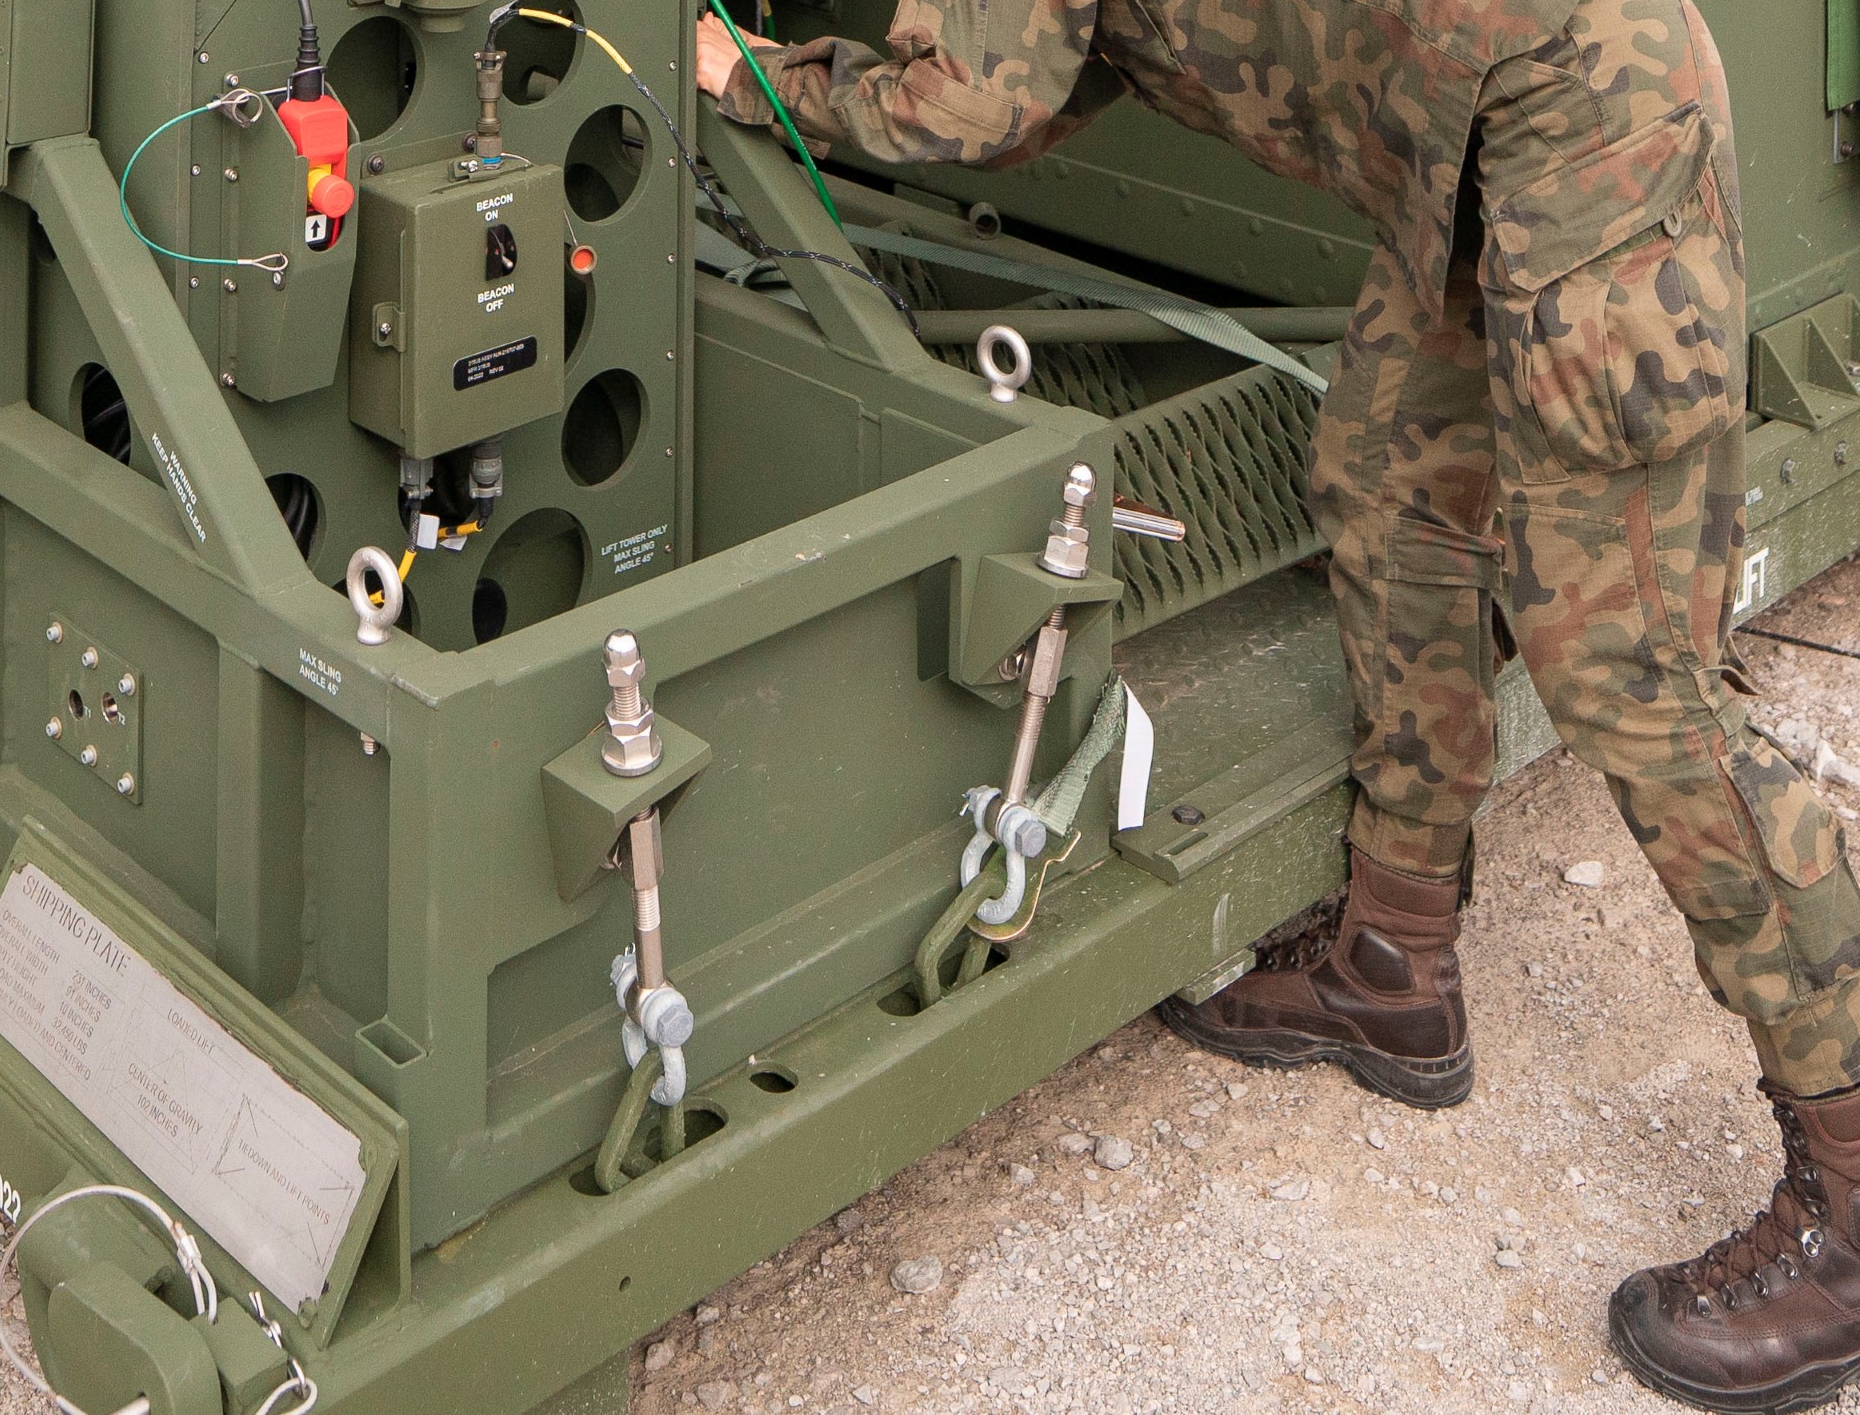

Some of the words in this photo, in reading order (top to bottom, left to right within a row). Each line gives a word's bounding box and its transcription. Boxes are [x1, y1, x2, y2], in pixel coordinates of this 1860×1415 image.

[476, 193, 513, 212] BEACON
[485, 209, 499, 221] ON
[477, 283, 515, 304] BEACON
[486, 299, 504, 313] OFF
[151, 432, 169, 463] KEEP
[166, 462, 187, 503] HANDS
[185, 502, 206, 543] CLEAR
[170, 450, 197, 505] WARNING
[601, 542, 618, 556] LIFT
[619, 532, 646, 548] TOWER
[647, 524, 668, 539] ONLY
[614, 549, 631, 563] MAX
[632, 540, 655, 556] SLING
[614, 557, 641, 575] ANGLE
[299, 664, 326, 689] ANGLE
[300, 648, 317, 668] MAX
[318, 659, 341, 683] SLING
[118, 712, 126, 725] T2
[22, 874, 88, 939] SHIPPING
[84, 926, 131, 978] PLATE
[2, 909, 34, 940] OVERALL
[32, 934, 61, 964] LENGTH
[84, 980, 112, 1010] INCHES
[11, 957, 39, 986] HEIGHT
[66, 1009, 94, 1038] INCHES
[24, 950, 49, 976] WIDTH
[74, 994, 102, 1022] INCHES
[13, 980, 46, 1016] MAXIMUM
[73, 1035, 88, 1055] LBS
[167, 1008, 198, 1041] LOADED
[196, 1034, 216, 1055] LIFT
[12, 1003, 39, 1033] LOADED
[39, 1027, 56, 1047] AND
[54, 1040, 91, 1081] CENTERED
[128, 1062, 158, 1096] CENTER
[157, 1089, 169, 1104] OF
[168, 1100, 203, 1136] GRAVITY
[137, 1094, 151, 1111] 102
[149, 1106, 179, 1138] INCHES
[270, 1168, 287, 1188] AND
[285, 1180, 302, 1201] LIFT
[301, 1195, 331, 1226] POINTS
